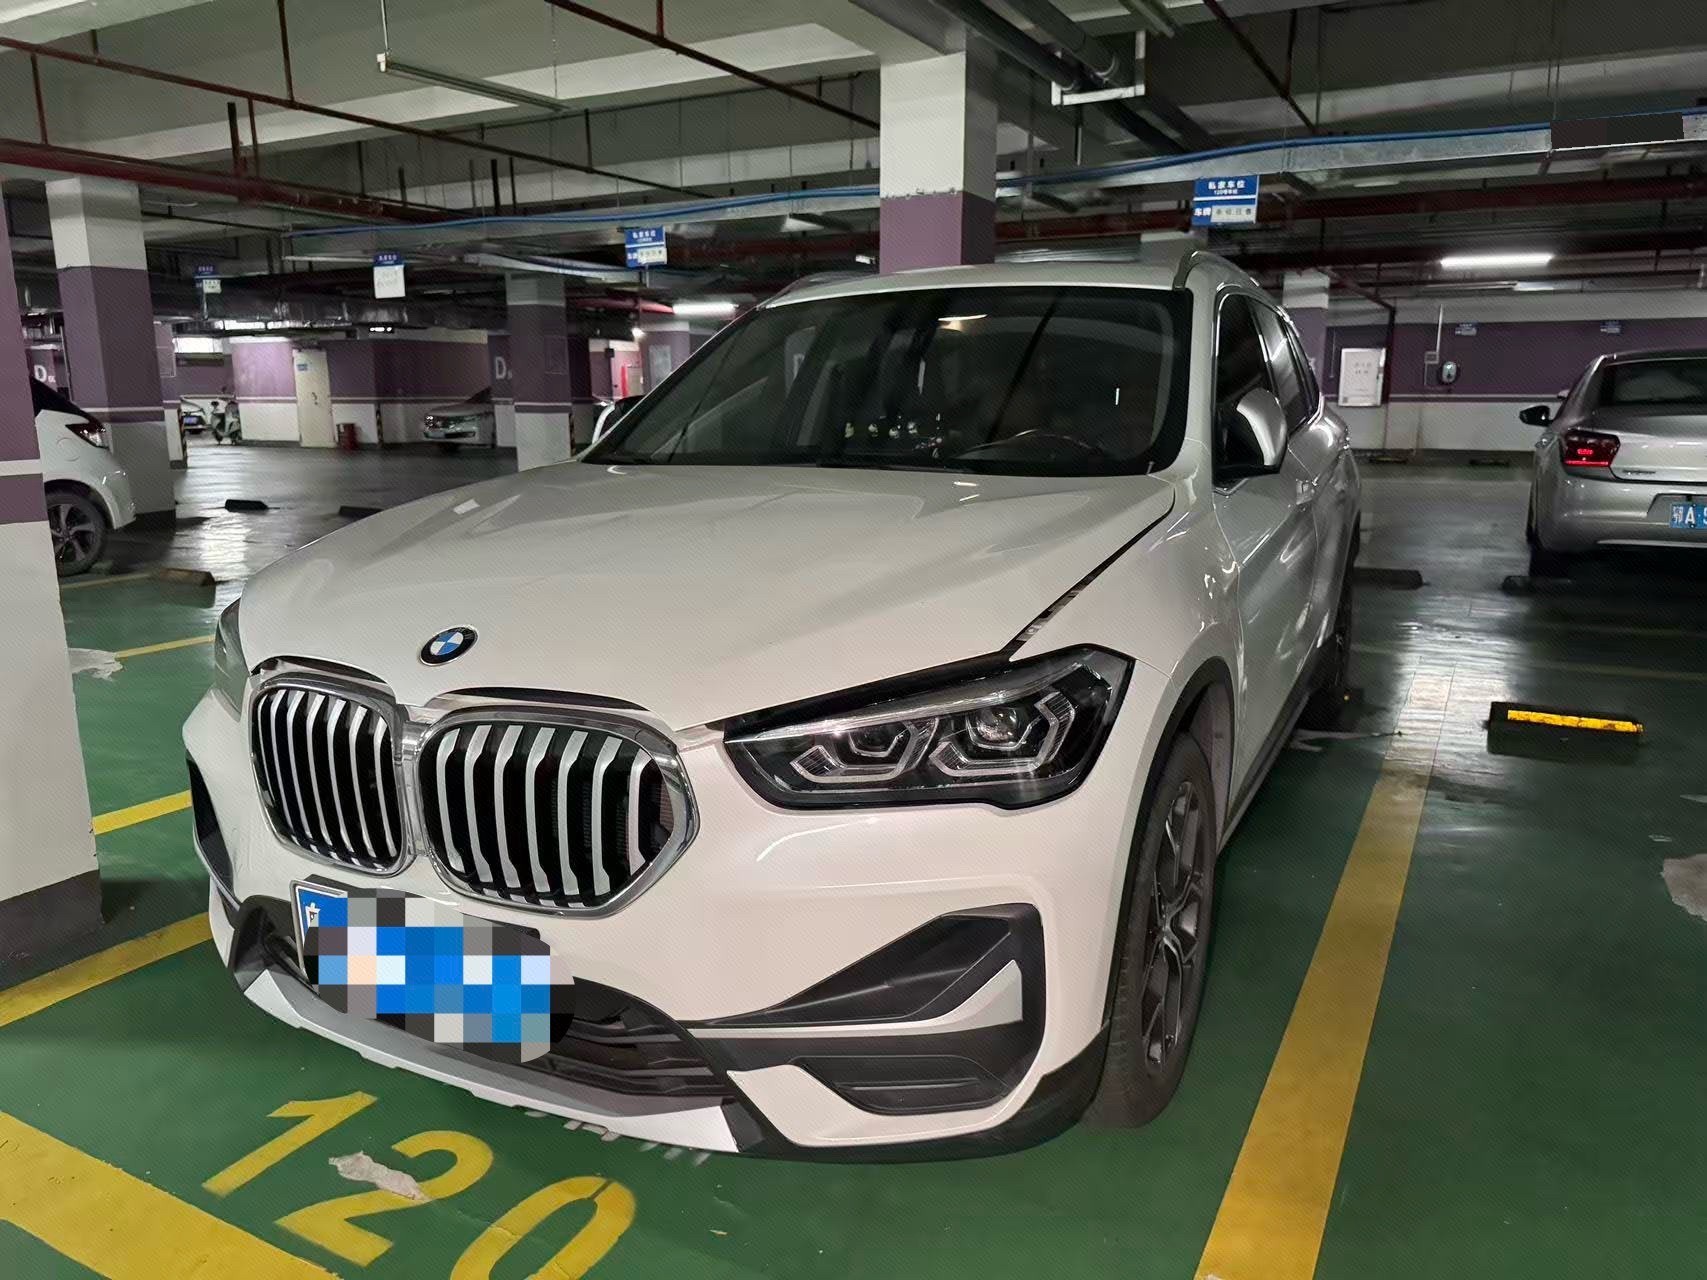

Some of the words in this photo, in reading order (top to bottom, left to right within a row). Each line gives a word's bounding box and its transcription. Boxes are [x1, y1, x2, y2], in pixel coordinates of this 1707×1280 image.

[1208, 180, 1245, 190] 私家车位
[202, 1090, 636, 1280] 120
